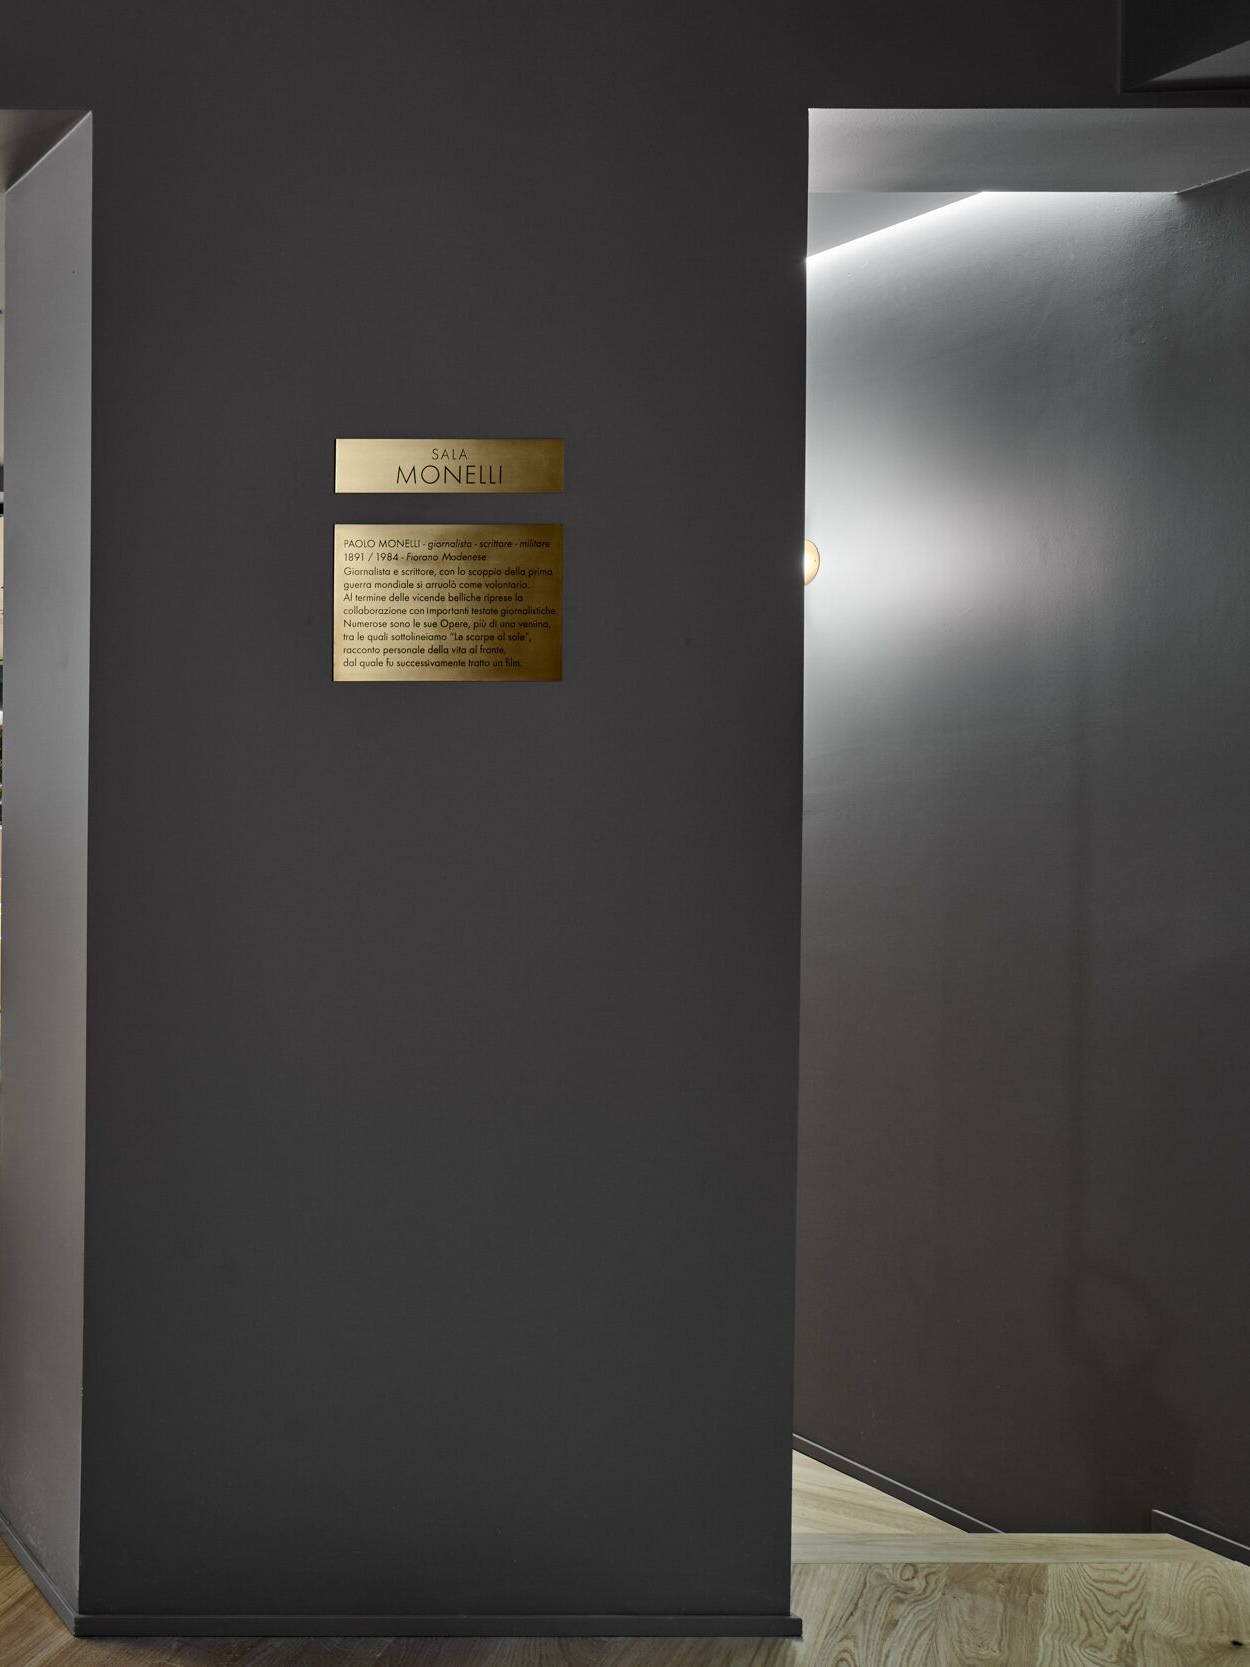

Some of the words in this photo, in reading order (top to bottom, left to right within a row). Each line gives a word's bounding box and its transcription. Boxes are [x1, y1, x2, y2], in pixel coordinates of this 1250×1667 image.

[431, 448, 468, 460] SALA
[396, 464, 502, 485] MONELLI
[344, 539, 376, 548] PAOLO
[378, 539, 420, 548] MONELLI
[428, 539, 472, 550] giornalista
[479, 540, 512, 548] scrittore
[520, 539, 550, 548] militare
[344, 552, 364, 562] 1891
[376, 552, 398, 562] 1984
[406, 552, 438, 561] Fiorano
[442, 552, 486, 561] Modenese
[344, 566, 390, 576] Giornalista
[402, 567, 436, 577] scrittore,
[458, 566, 466, 576] lo
[468, 568, 502, 578] scoppio
[504, 566, 526, 576] della
[528, 568, 553, 578] prima
[343, 582, 372, 591] guerra
[374, 579, 414, 588] mondiale
[416, 580, 422, 588] si
[426, 579, 456, 589] arruolò
[342, 592, 352, 602] Al
[356, 594, 386, 602] termine
[388, 592, 410, 602] delle
[412, 592, 446, 602] vicende
[448, 592, 481, 602] belliche
[484, 594, 512, 604] riprese
[515, 592, 524, 602] la
[343, 605, 407, 614] collaborazione
[426, 606, 468, 618] importanti
[472, 606, 498, 614] testate
[343, 618, 388, 628] Numerose
[412, 618, 420, 628] le
[440, 618, 470, 630] Opere,
[474, 620, 486, 630] più
[489, 618, 497, 628] di
[518, 620, 550, 630] ventina,
[356, 632, 364, 640] le
[367, 632, 388, 644] quali
[390, 632, 448, 640] sottolineiamo
[466, 634, 494, 644] scarpe
[497, 632, 506, 640] al
[382, 644, 425, 656] personale
[428, 644, 448, 654] della
[452, 646, 466, 654] vita
[469, 644, 477, 654] al
[342, 658, 356, 667] dal
[360, 658, 384, 670] quale
[386, 658, 394, 667] fu
[396, 659, 466, 668] successivamente
[468, 659, 490, 667] tratto
